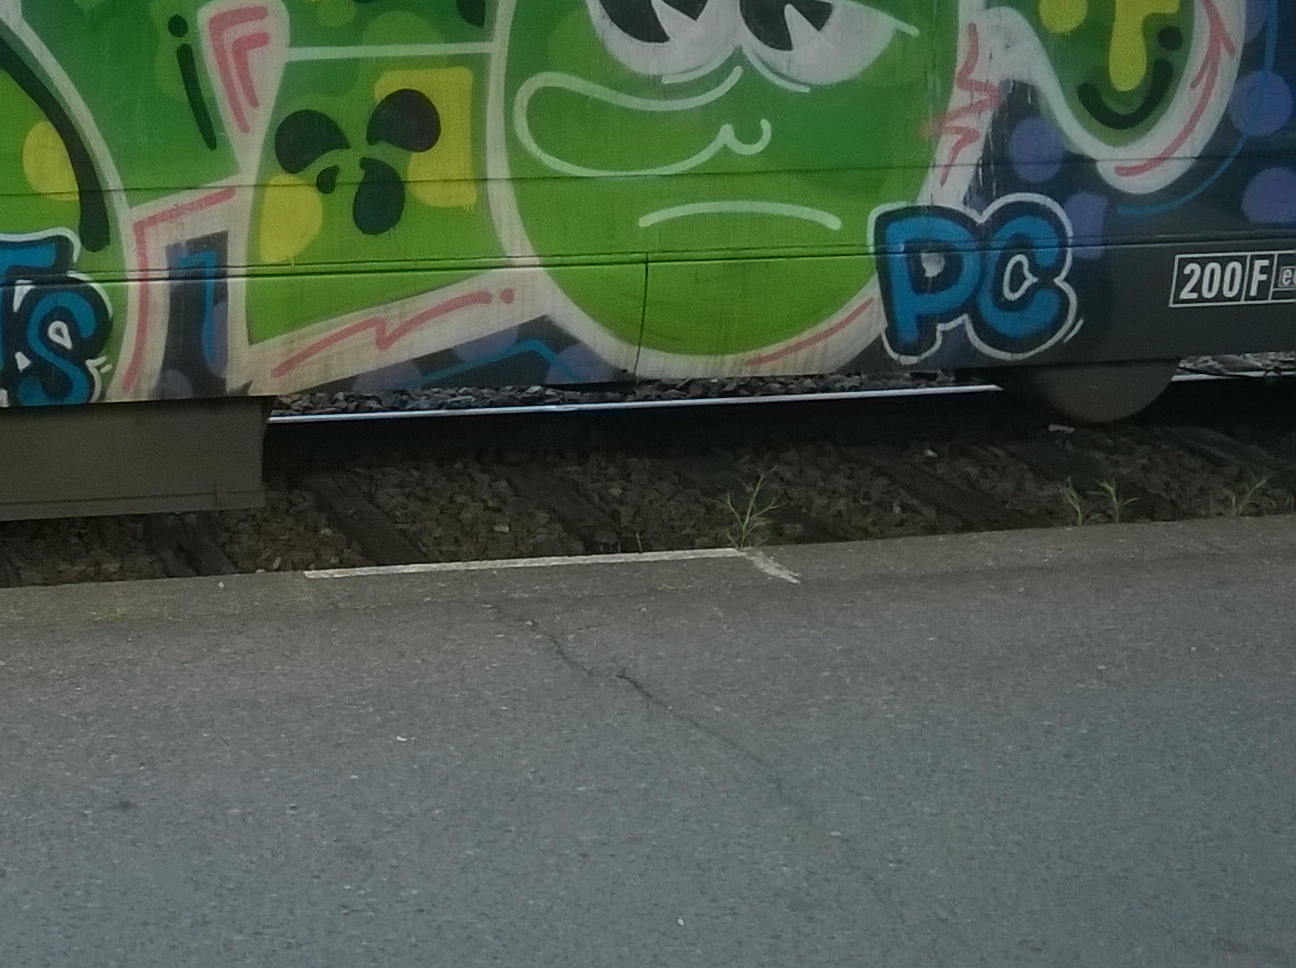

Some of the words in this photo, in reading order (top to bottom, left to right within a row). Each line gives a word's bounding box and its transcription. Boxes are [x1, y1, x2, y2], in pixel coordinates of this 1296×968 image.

[876, 202, 1068, 355] PC
[1179, 261, 1243, 300] 200
[1249, 259, 1270, 297] F
